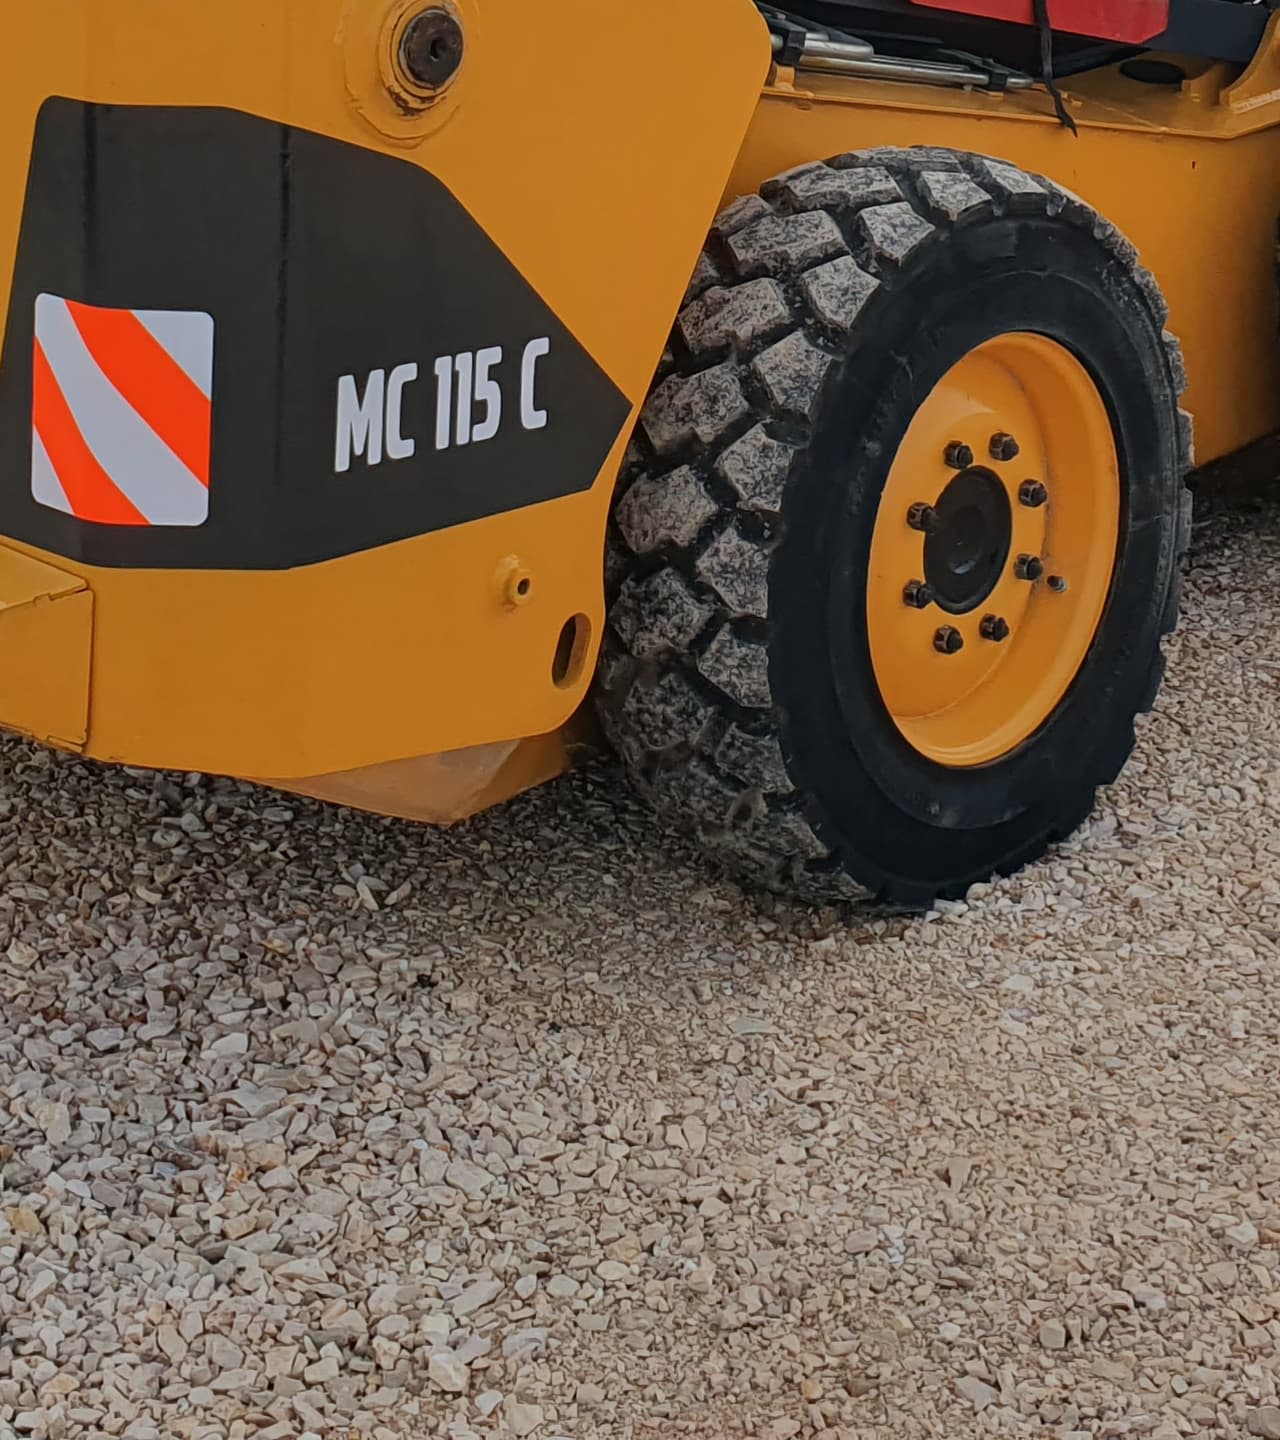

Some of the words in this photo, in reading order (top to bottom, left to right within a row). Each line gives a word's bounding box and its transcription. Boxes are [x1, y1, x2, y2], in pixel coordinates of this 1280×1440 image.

[333, 361, 419, 473] MC
[433, 345, 503, 450] 115
[519, 336, 551, 431] C
